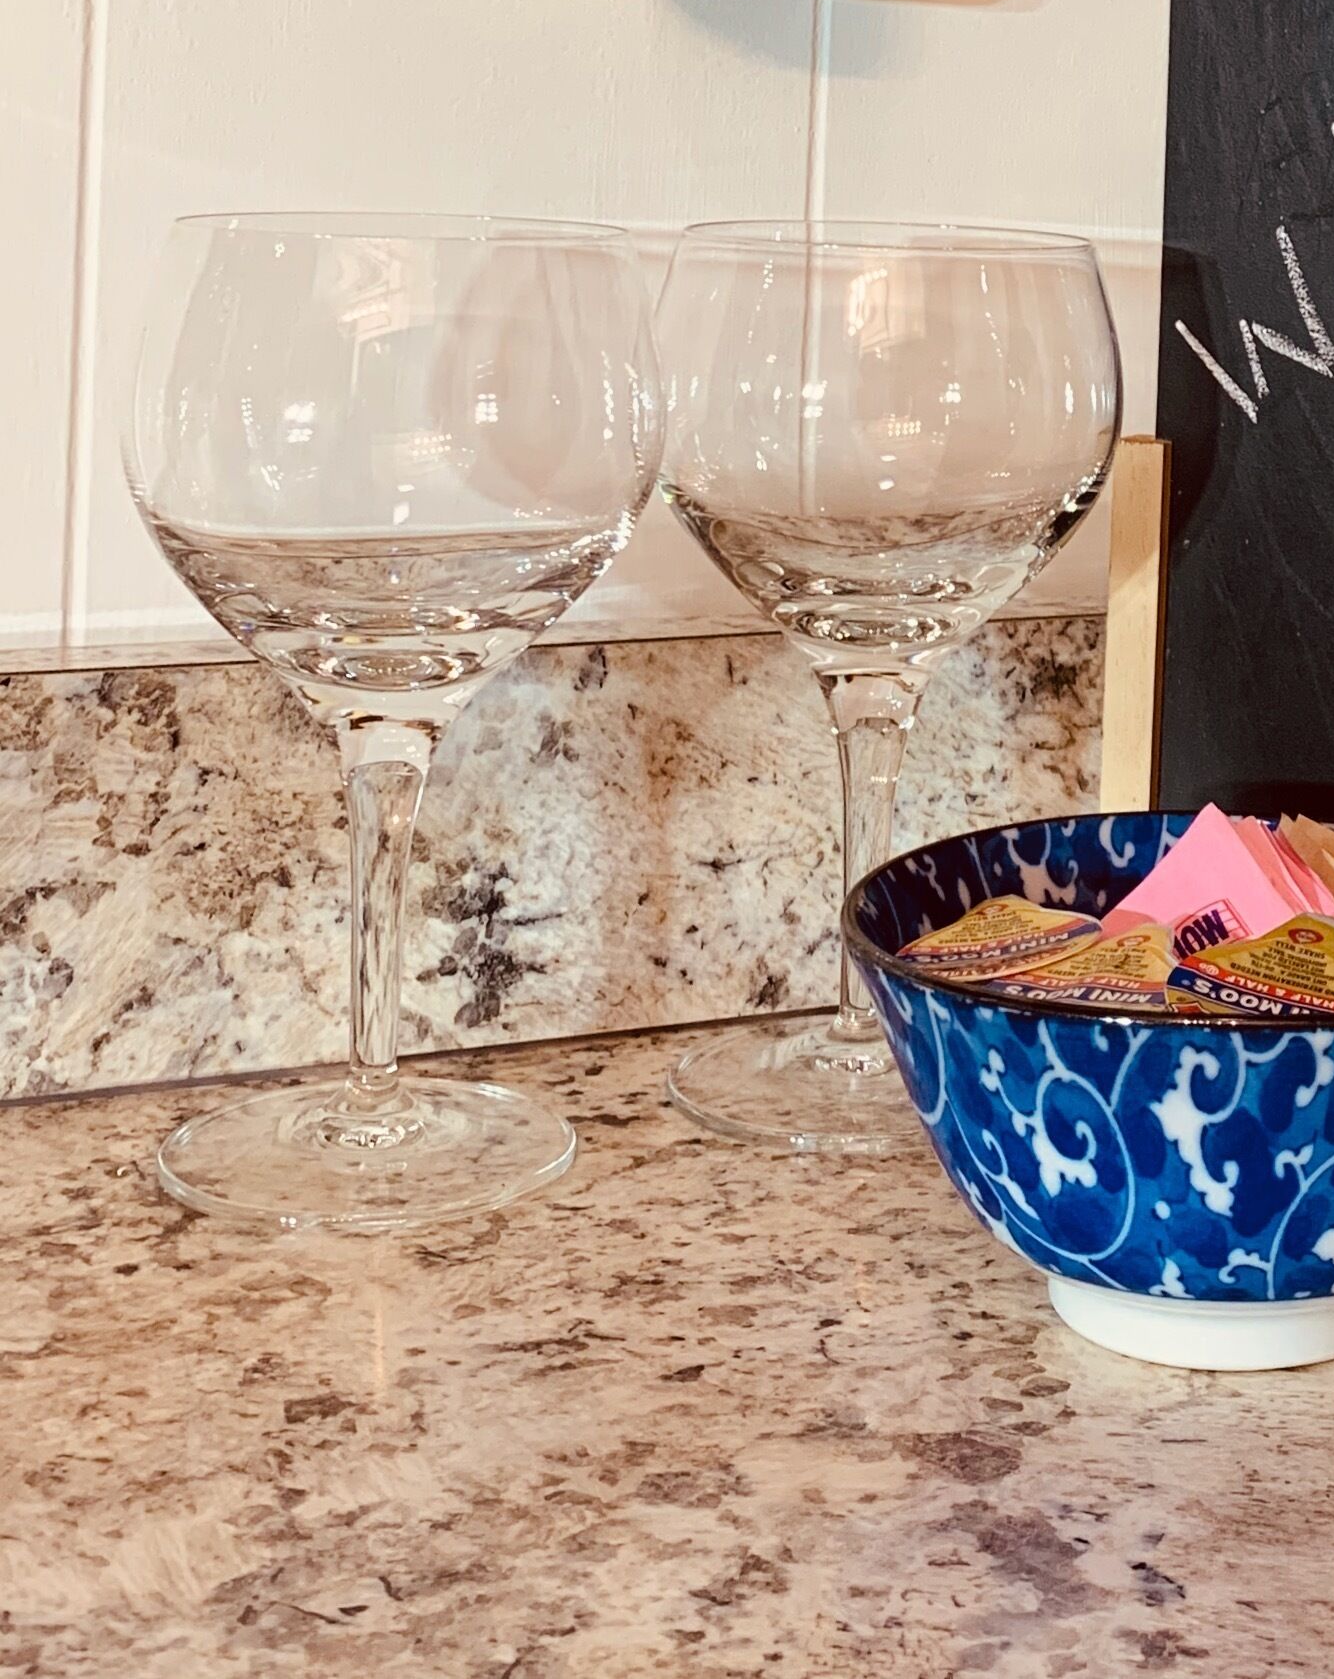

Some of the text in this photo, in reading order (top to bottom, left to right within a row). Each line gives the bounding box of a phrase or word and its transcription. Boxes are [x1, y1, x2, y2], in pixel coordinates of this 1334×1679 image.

[1010, 932, 1069, 952] MINI
[1224, 975, 1270, 994] HALF
[1087, 989, 1153, 1004] MINI
